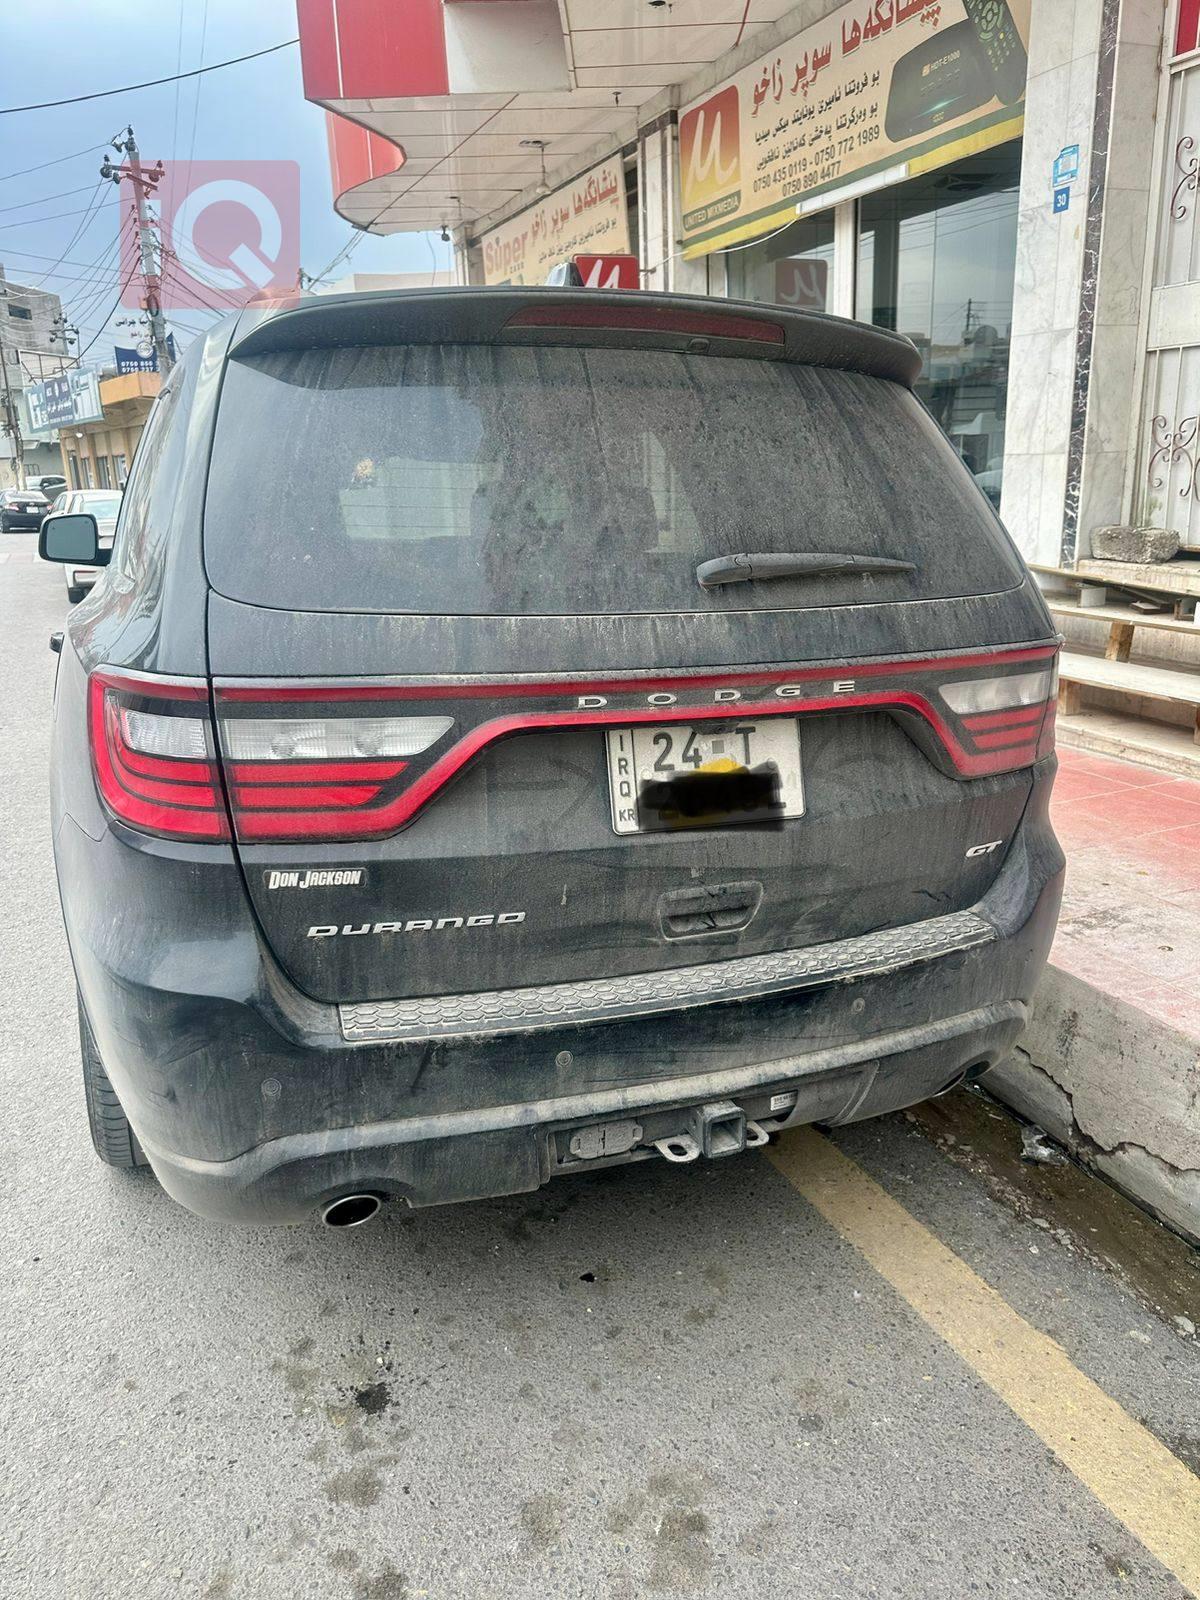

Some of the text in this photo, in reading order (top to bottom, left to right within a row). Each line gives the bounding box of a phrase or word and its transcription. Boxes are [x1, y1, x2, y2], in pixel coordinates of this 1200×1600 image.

[753, 174, 771, 193] 0750
[772, 166, 787, 184] 435
[788, 158, 808, 178] 0119
[814, 144, 836, 166] 0750
[838, 136, 854, 157] 772
[857, 124, 880, 147] 1989
[782, 160, 841, 197] 0750 890 4477
[1056, 193, 1067, 208] 30
[578, 680, 856, 709] DODGE
[617, 734, 632, 798] IRQ
[652, 731, 702, 772] 24
[618, 806, 635, 822] KR
[966, 840, 1003, 857] GT
[307, 911, 526, 937] DURANGO
